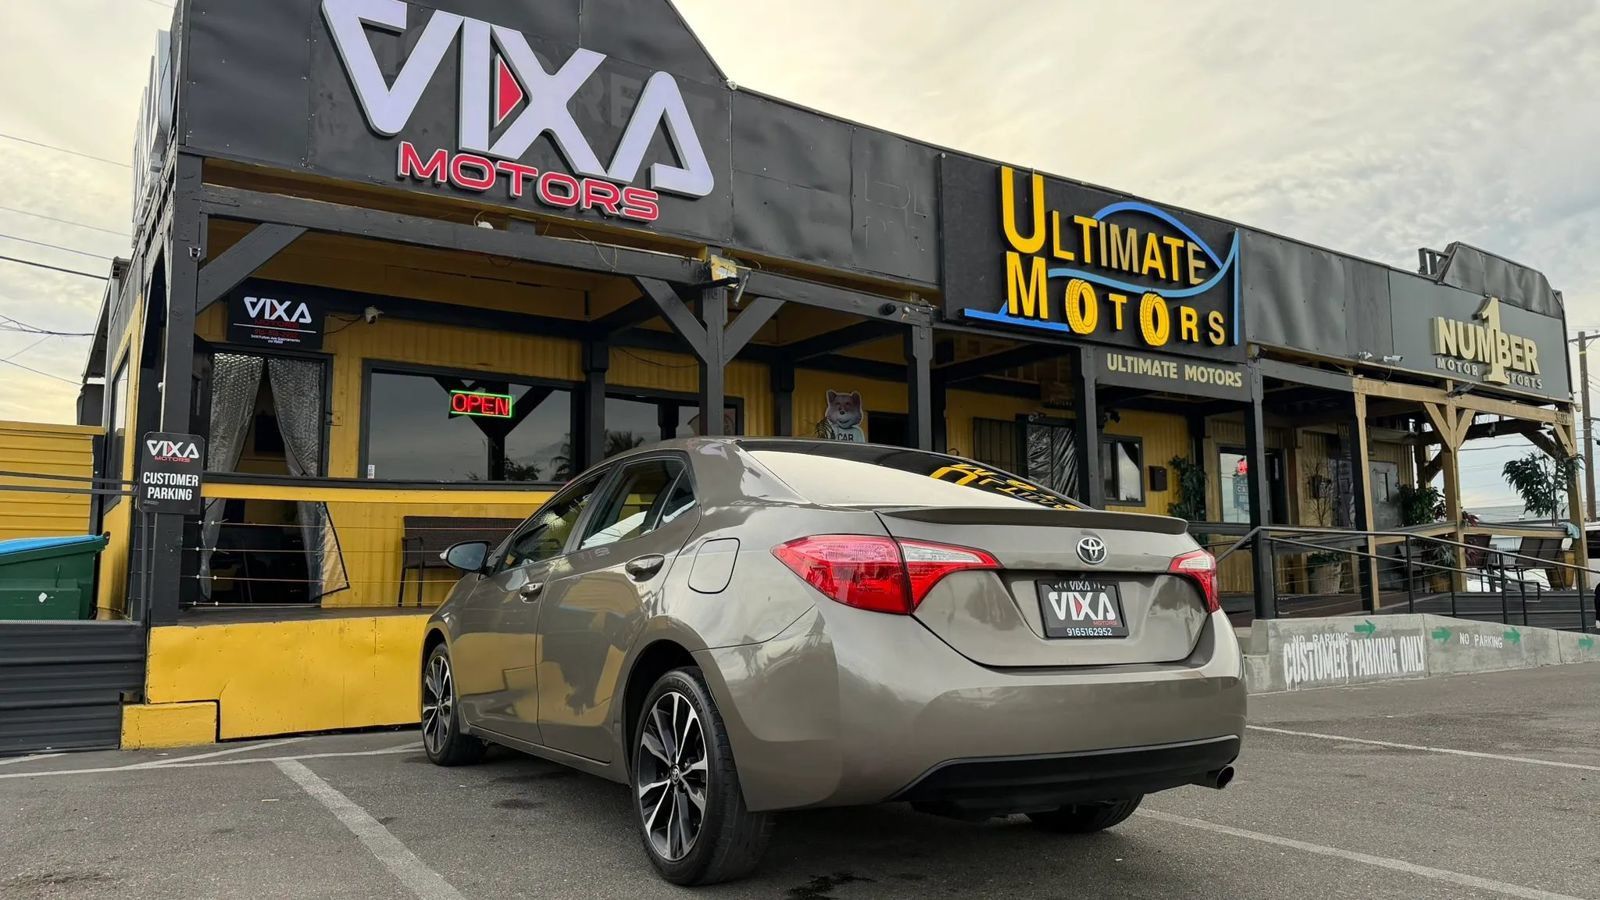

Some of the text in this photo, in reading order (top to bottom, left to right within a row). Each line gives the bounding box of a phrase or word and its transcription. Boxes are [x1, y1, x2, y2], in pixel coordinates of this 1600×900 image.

[321, 0, 714, 198] VIXA
[397, 140, 660, 222] MOTORS
[1000, 165, 1207, 286] ULTIMATE
[243, 296, 312, 324] VIXA
[1005, 250, 1226, 347] MOTORS
[1432, 316, 1541, 375] NUMBER
[1106, 352, 1243, 388] ULTIMATE MOTORS
[1435, 356, 1543, 390] MOTOR SPORTS
[452, 393, 509, 416] OPEN
[146, 439, 200, 459] VIXA
[154, 455, 191, 463] MOTORS
[143, 471, 199, 487] CUSTOMER
[147, 486, 193, 501] PARKING
[1069, 580, 1091, 591] VIXA
[1048, 591, 1116, 621] VIXA
[1066, 627, 1113, 637] 9165162952
[1459, 632, 1503, 649] NO PARKING
[1283, 634, 1425, 684] CUSTOMER PARKING ONLY
